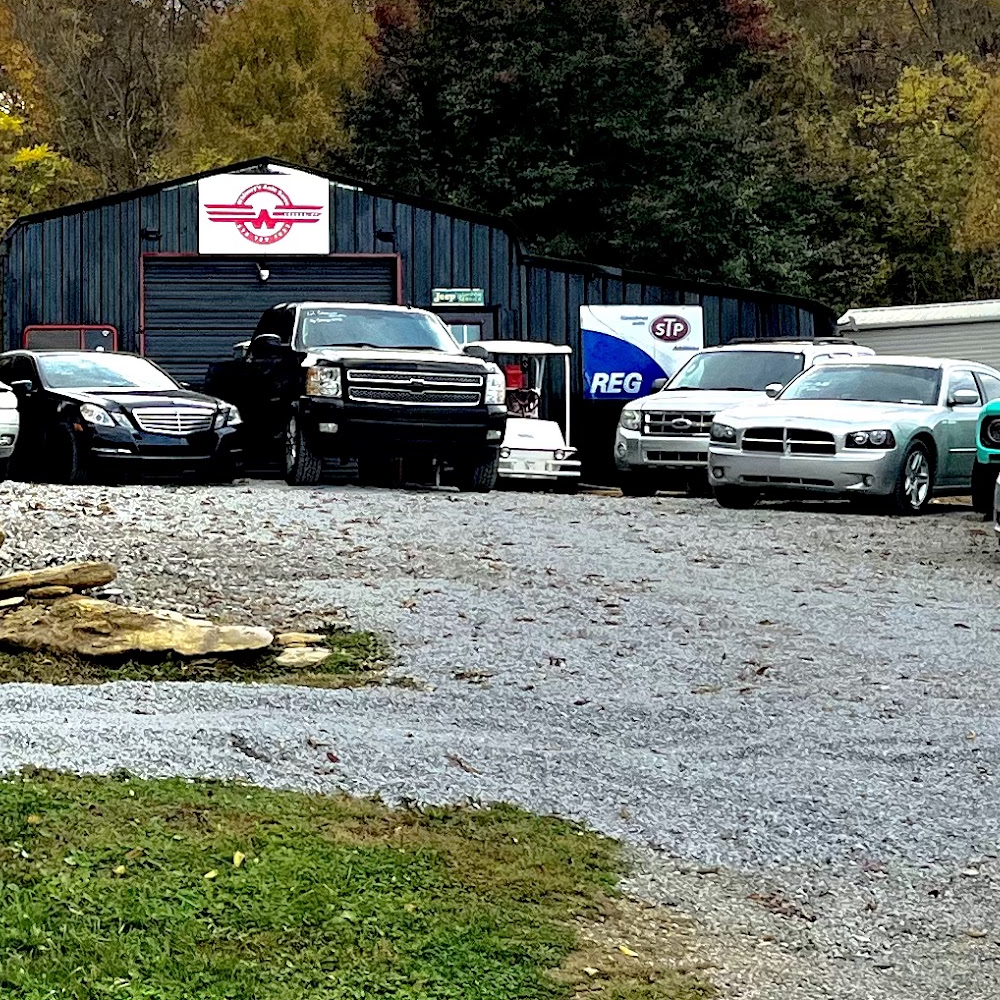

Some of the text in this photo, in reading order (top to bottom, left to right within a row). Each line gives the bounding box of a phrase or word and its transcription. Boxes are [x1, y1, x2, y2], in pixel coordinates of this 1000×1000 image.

[433, 292, 456, 303] Jeep
[655, 318, 685, 337] STP
[590, 372, 643, 394] REG
